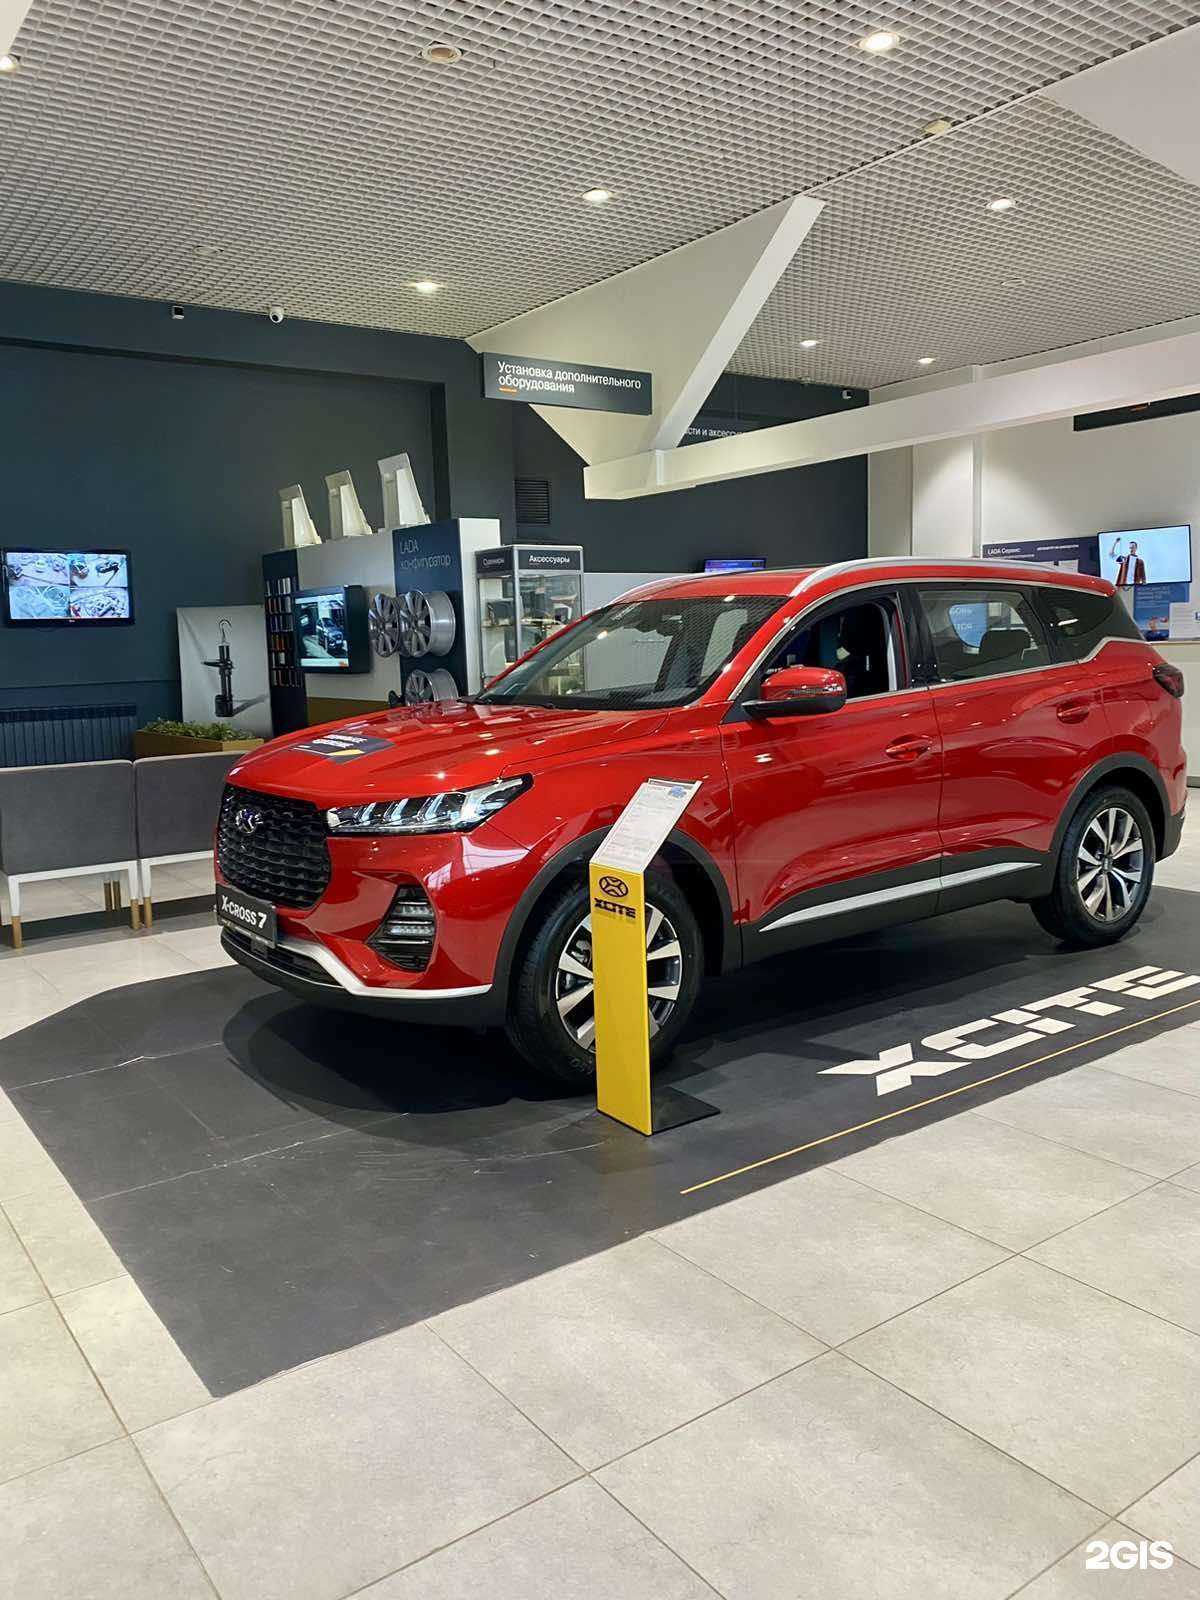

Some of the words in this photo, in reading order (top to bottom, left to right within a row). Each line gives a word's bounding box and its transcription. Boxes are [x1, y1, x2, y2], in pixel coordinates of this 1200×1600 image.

[498, 361, 553, 379] Установка
[555, 370, 641, 389] дополнительного
[498, 374, 575, 393] оборудования
[400, 539, 420, 554] LADA
[529, 555, 570, 564] Аксессуары
[221, 895, 257, 925] X-CROSS
[258, 912, 267, 928] 7
[594, 898, 636, 918] XCITE
[816, 965, 1200, 1097] XCITE
